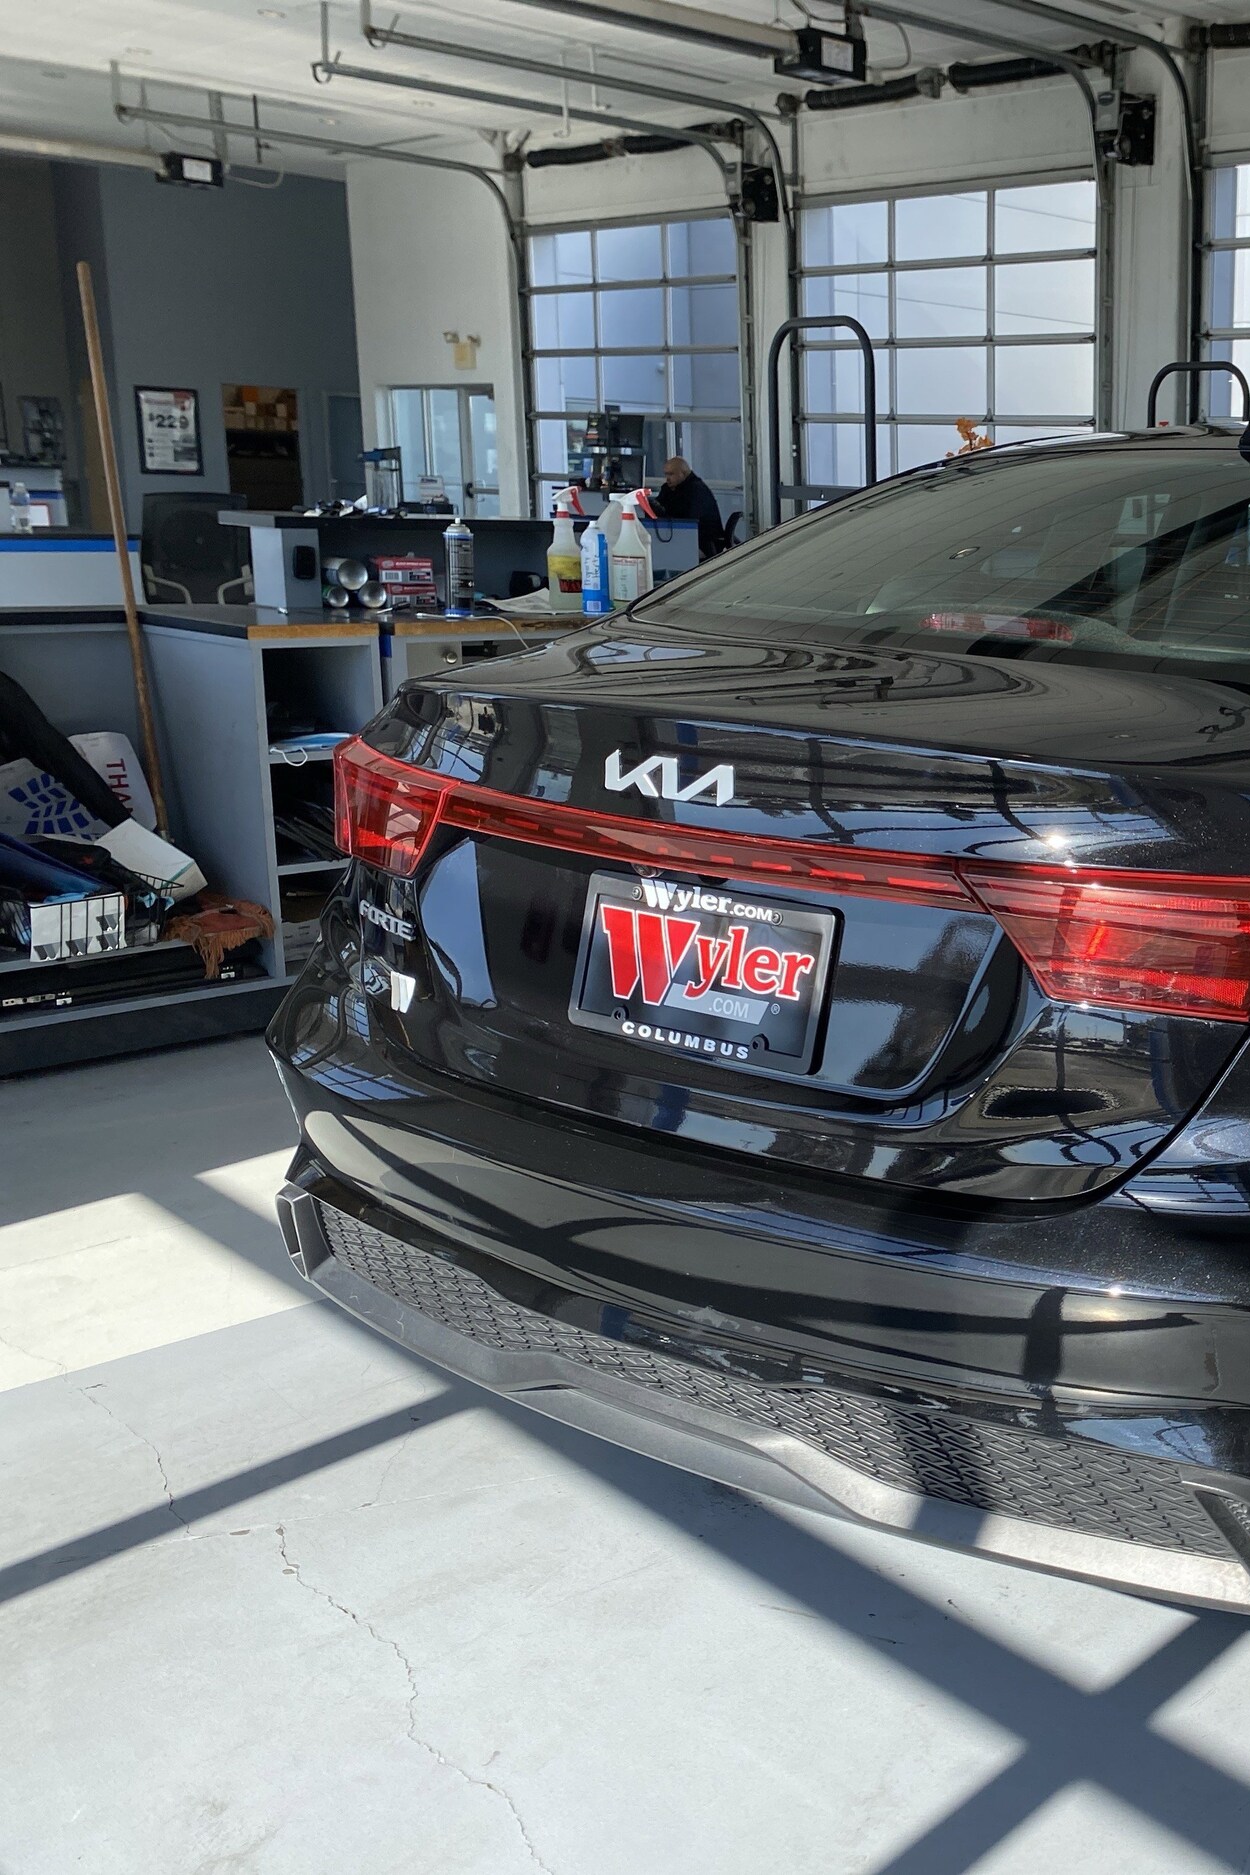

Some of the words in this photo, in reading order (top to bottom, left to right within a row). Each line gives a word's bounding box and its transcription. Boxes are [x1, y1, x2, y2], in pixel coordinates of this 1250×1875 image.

[106, 758, 134, 815] THA
[604, 749, 734, 807] KIA
[360, 900, 416, 941] FORTE
[600, 903, 815, 1007] Wyler
[708, 997, 749, 1019] .COM
[622, 1021, 749, 1060] COLUMBUS
